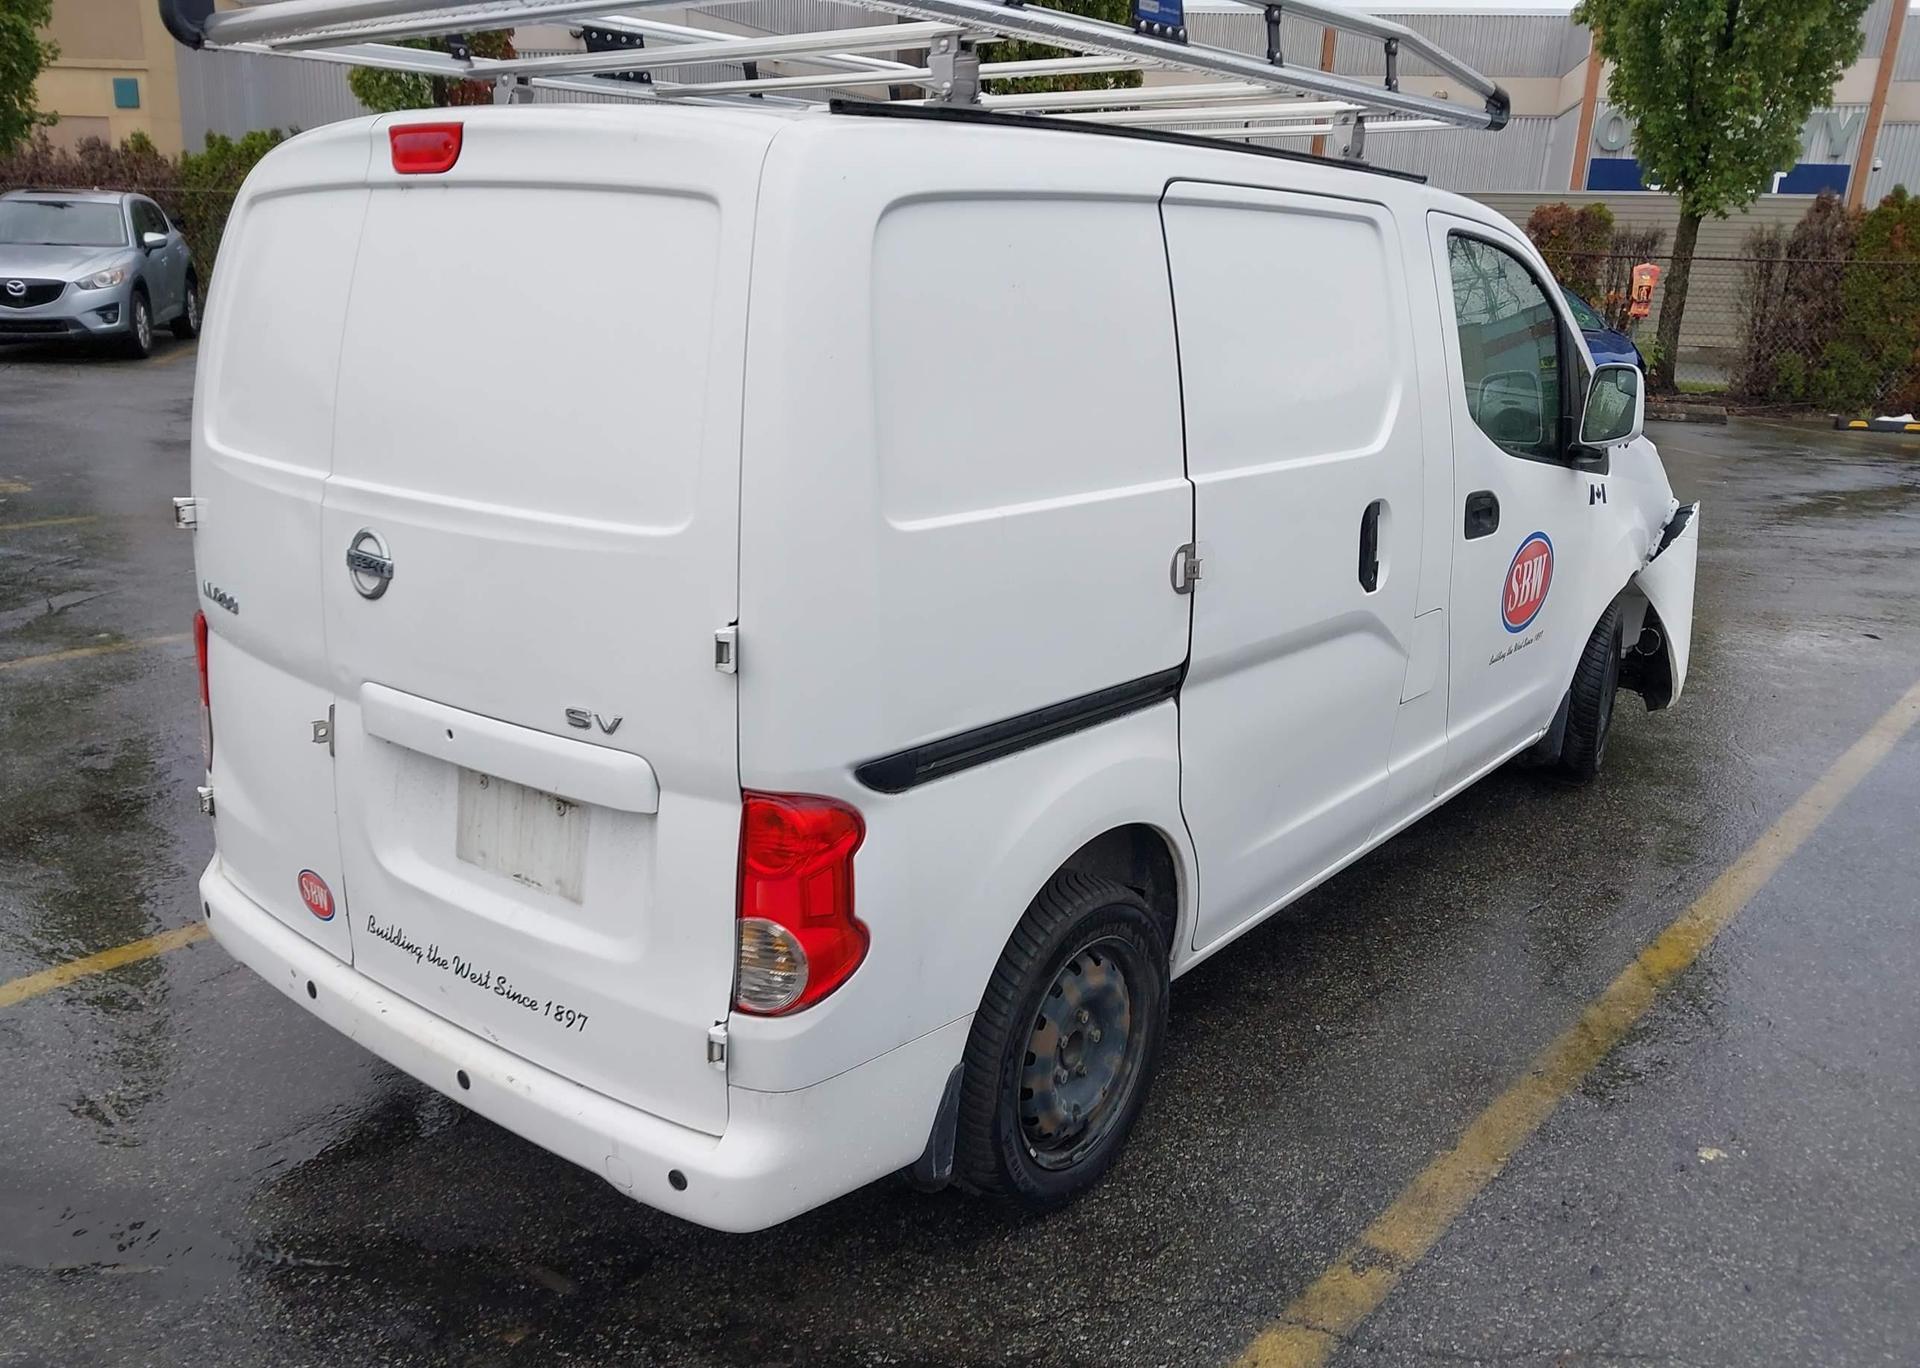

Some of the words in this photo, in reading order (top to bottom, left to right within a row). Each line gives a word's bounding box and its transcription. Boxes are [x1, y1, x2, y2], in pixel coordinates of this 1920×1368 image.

[1507, 552, 1548, 613] SBW
[565, 707, 624, 736] SV
[301, 876, 329, 912] SBW
[366, 914, 424, 964] Building
[426, 943, 450, 971] the
[452, 955, 492, 990] West
[493, 975, 540, 1012] Since
[543, 1000, 590, 1033] 1897
